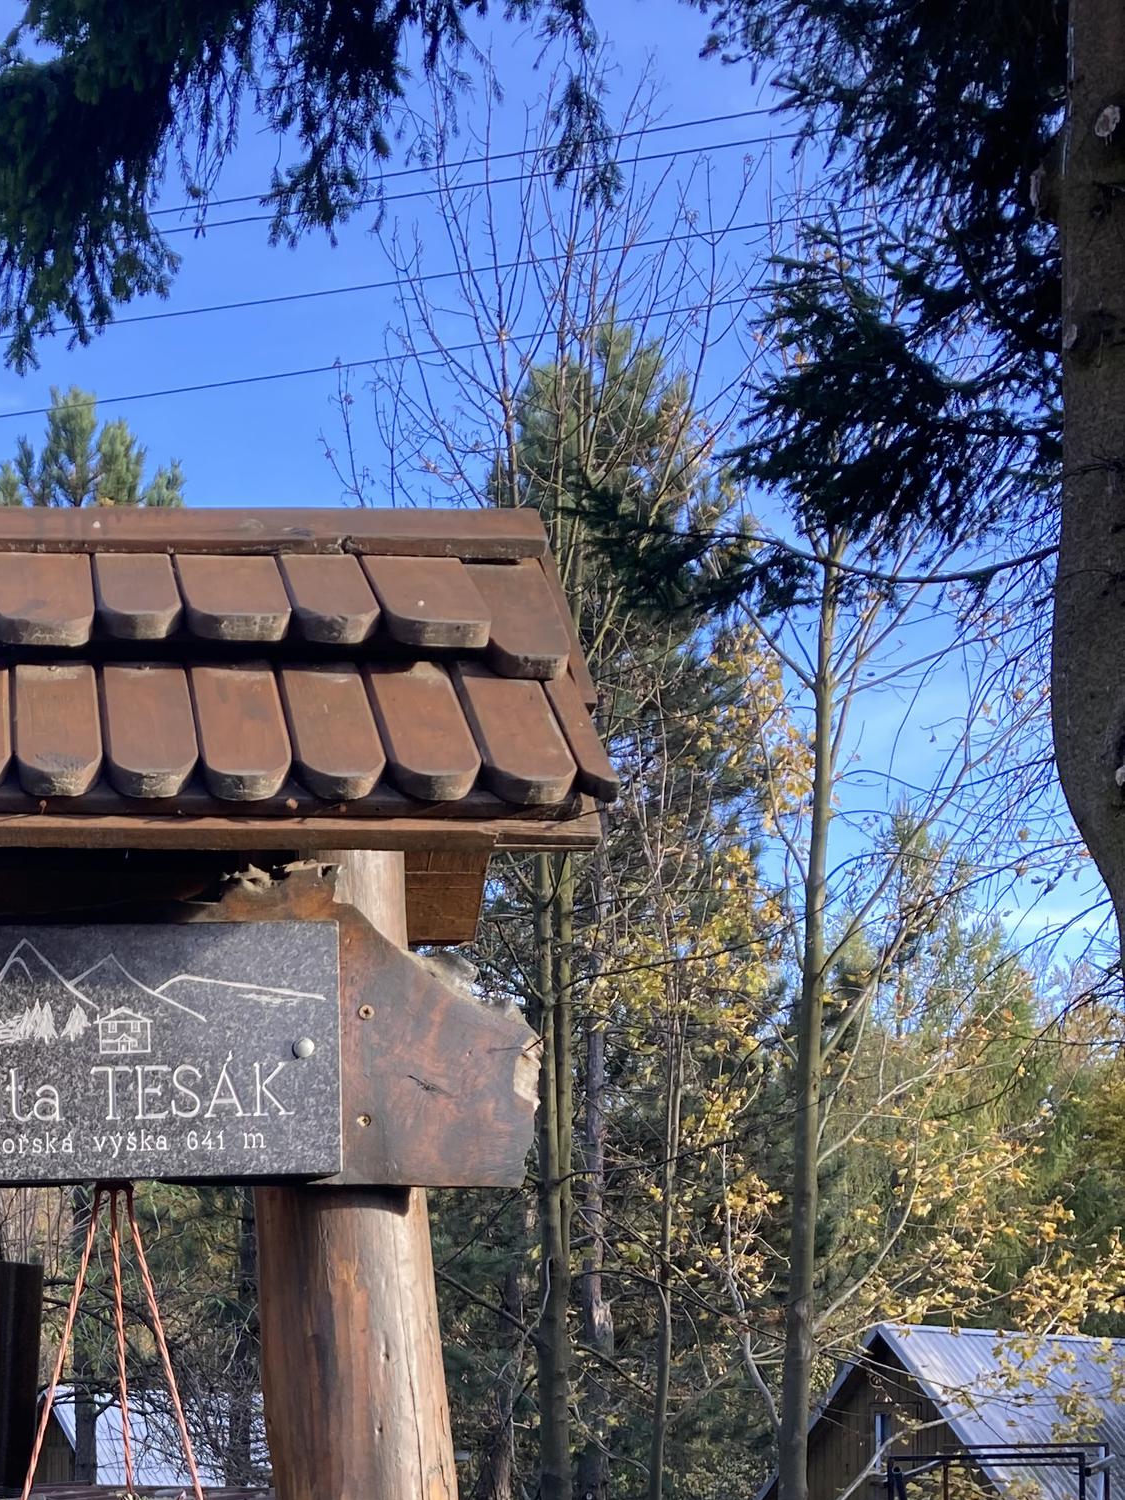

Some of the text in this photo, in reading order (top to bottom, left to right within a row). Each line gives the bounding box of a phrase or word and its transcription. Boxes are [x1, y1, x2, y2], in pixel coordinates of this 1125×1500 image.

[90, 1050, 295, 1120] TESÁK
[93, 1129, 169, 1158] výška
[186, 1129, 226, 1151] 641
[242, 1131, 267, 1149] m
